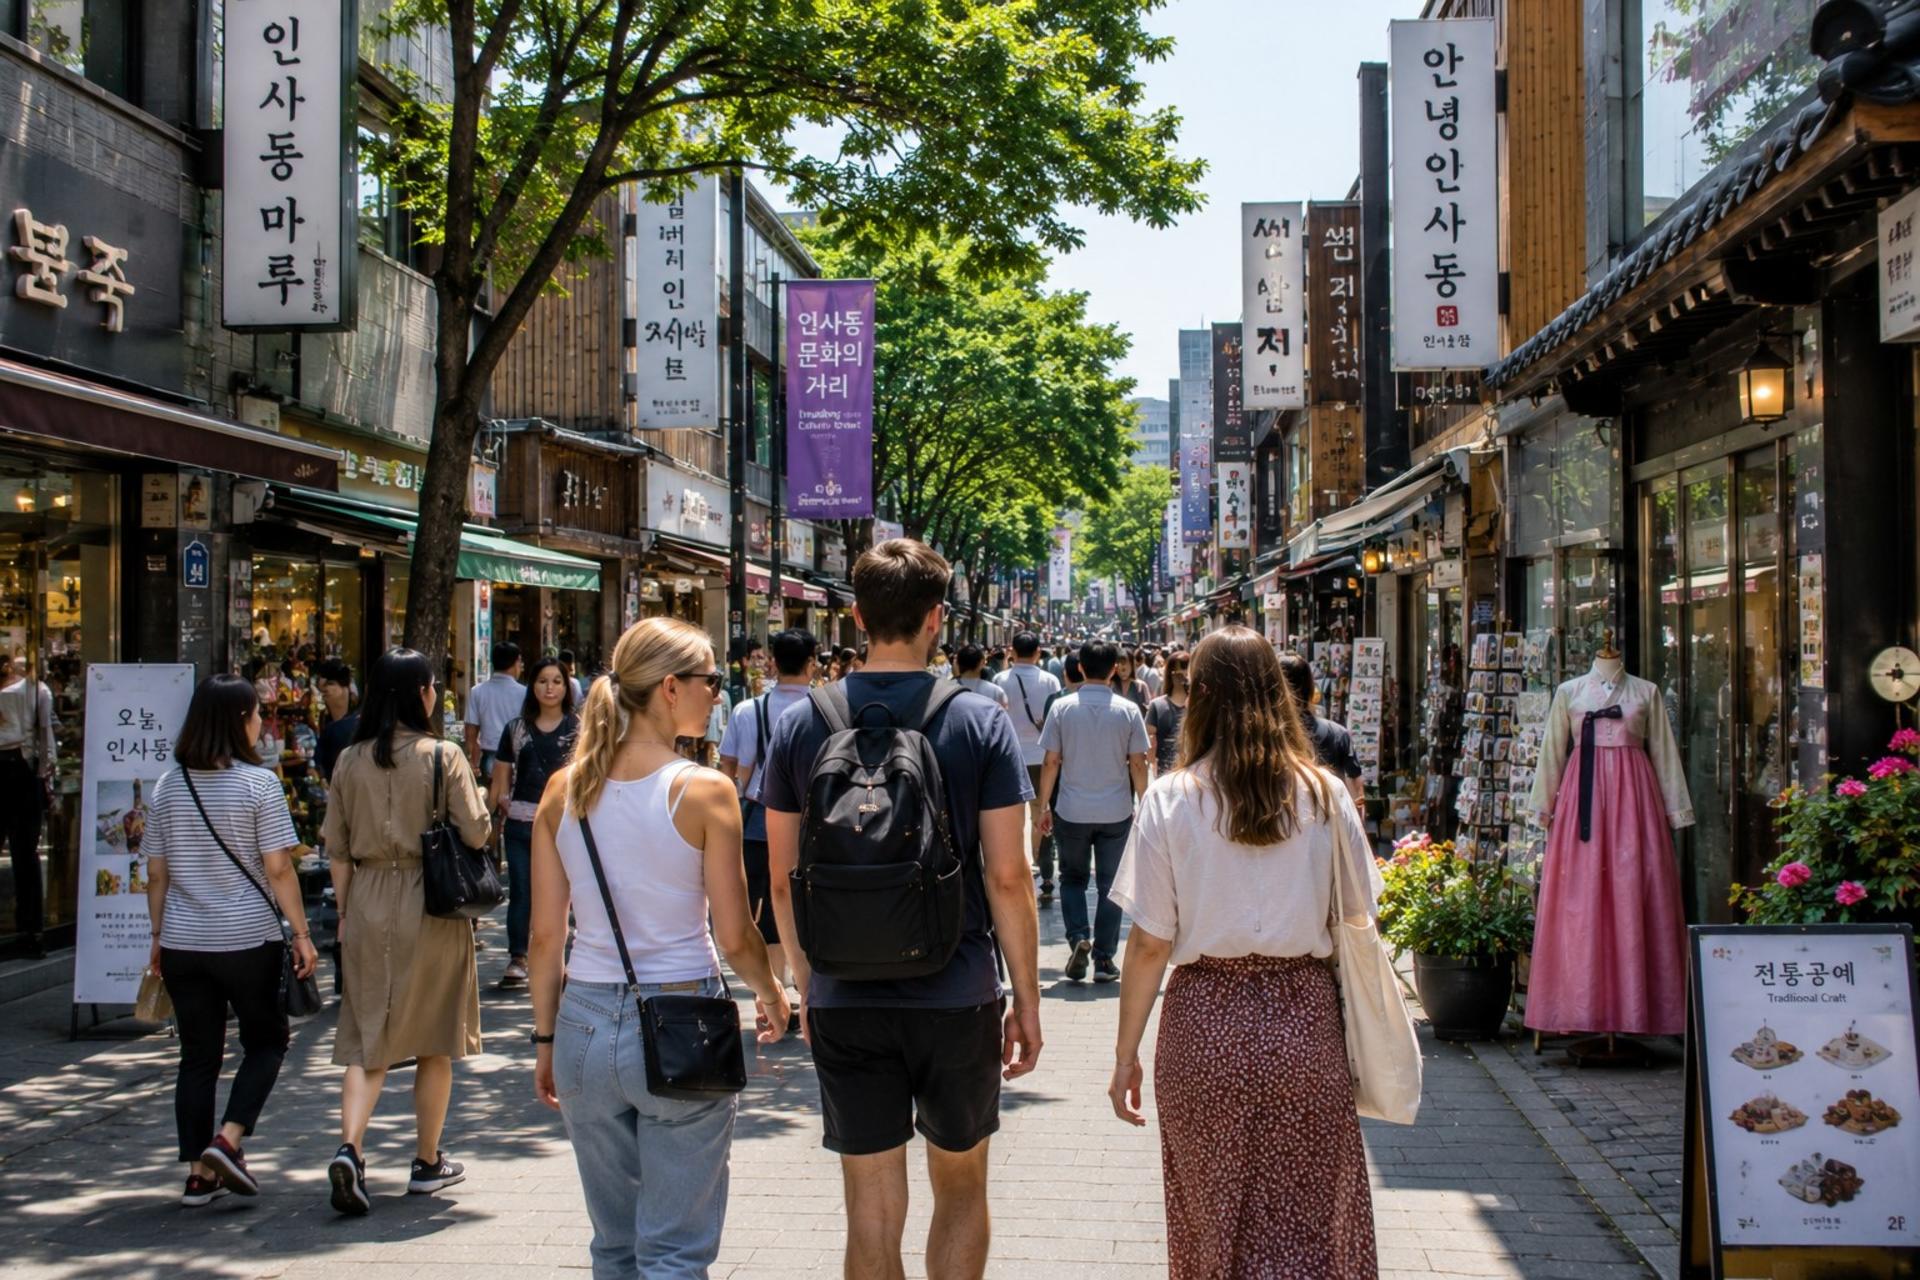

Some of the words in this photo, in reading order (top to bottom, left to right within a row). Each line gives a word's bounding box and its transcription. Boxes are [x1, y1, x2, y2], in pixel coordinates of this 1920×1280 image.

[259, 16, 305, 306] 인사동마루
[798, 311, 864, 336] 인사동
[797, 341, 862, 367] 문화의
[806, 373, 847, 400] 거리
[1754, 961, 1855, 987] 전통공예
